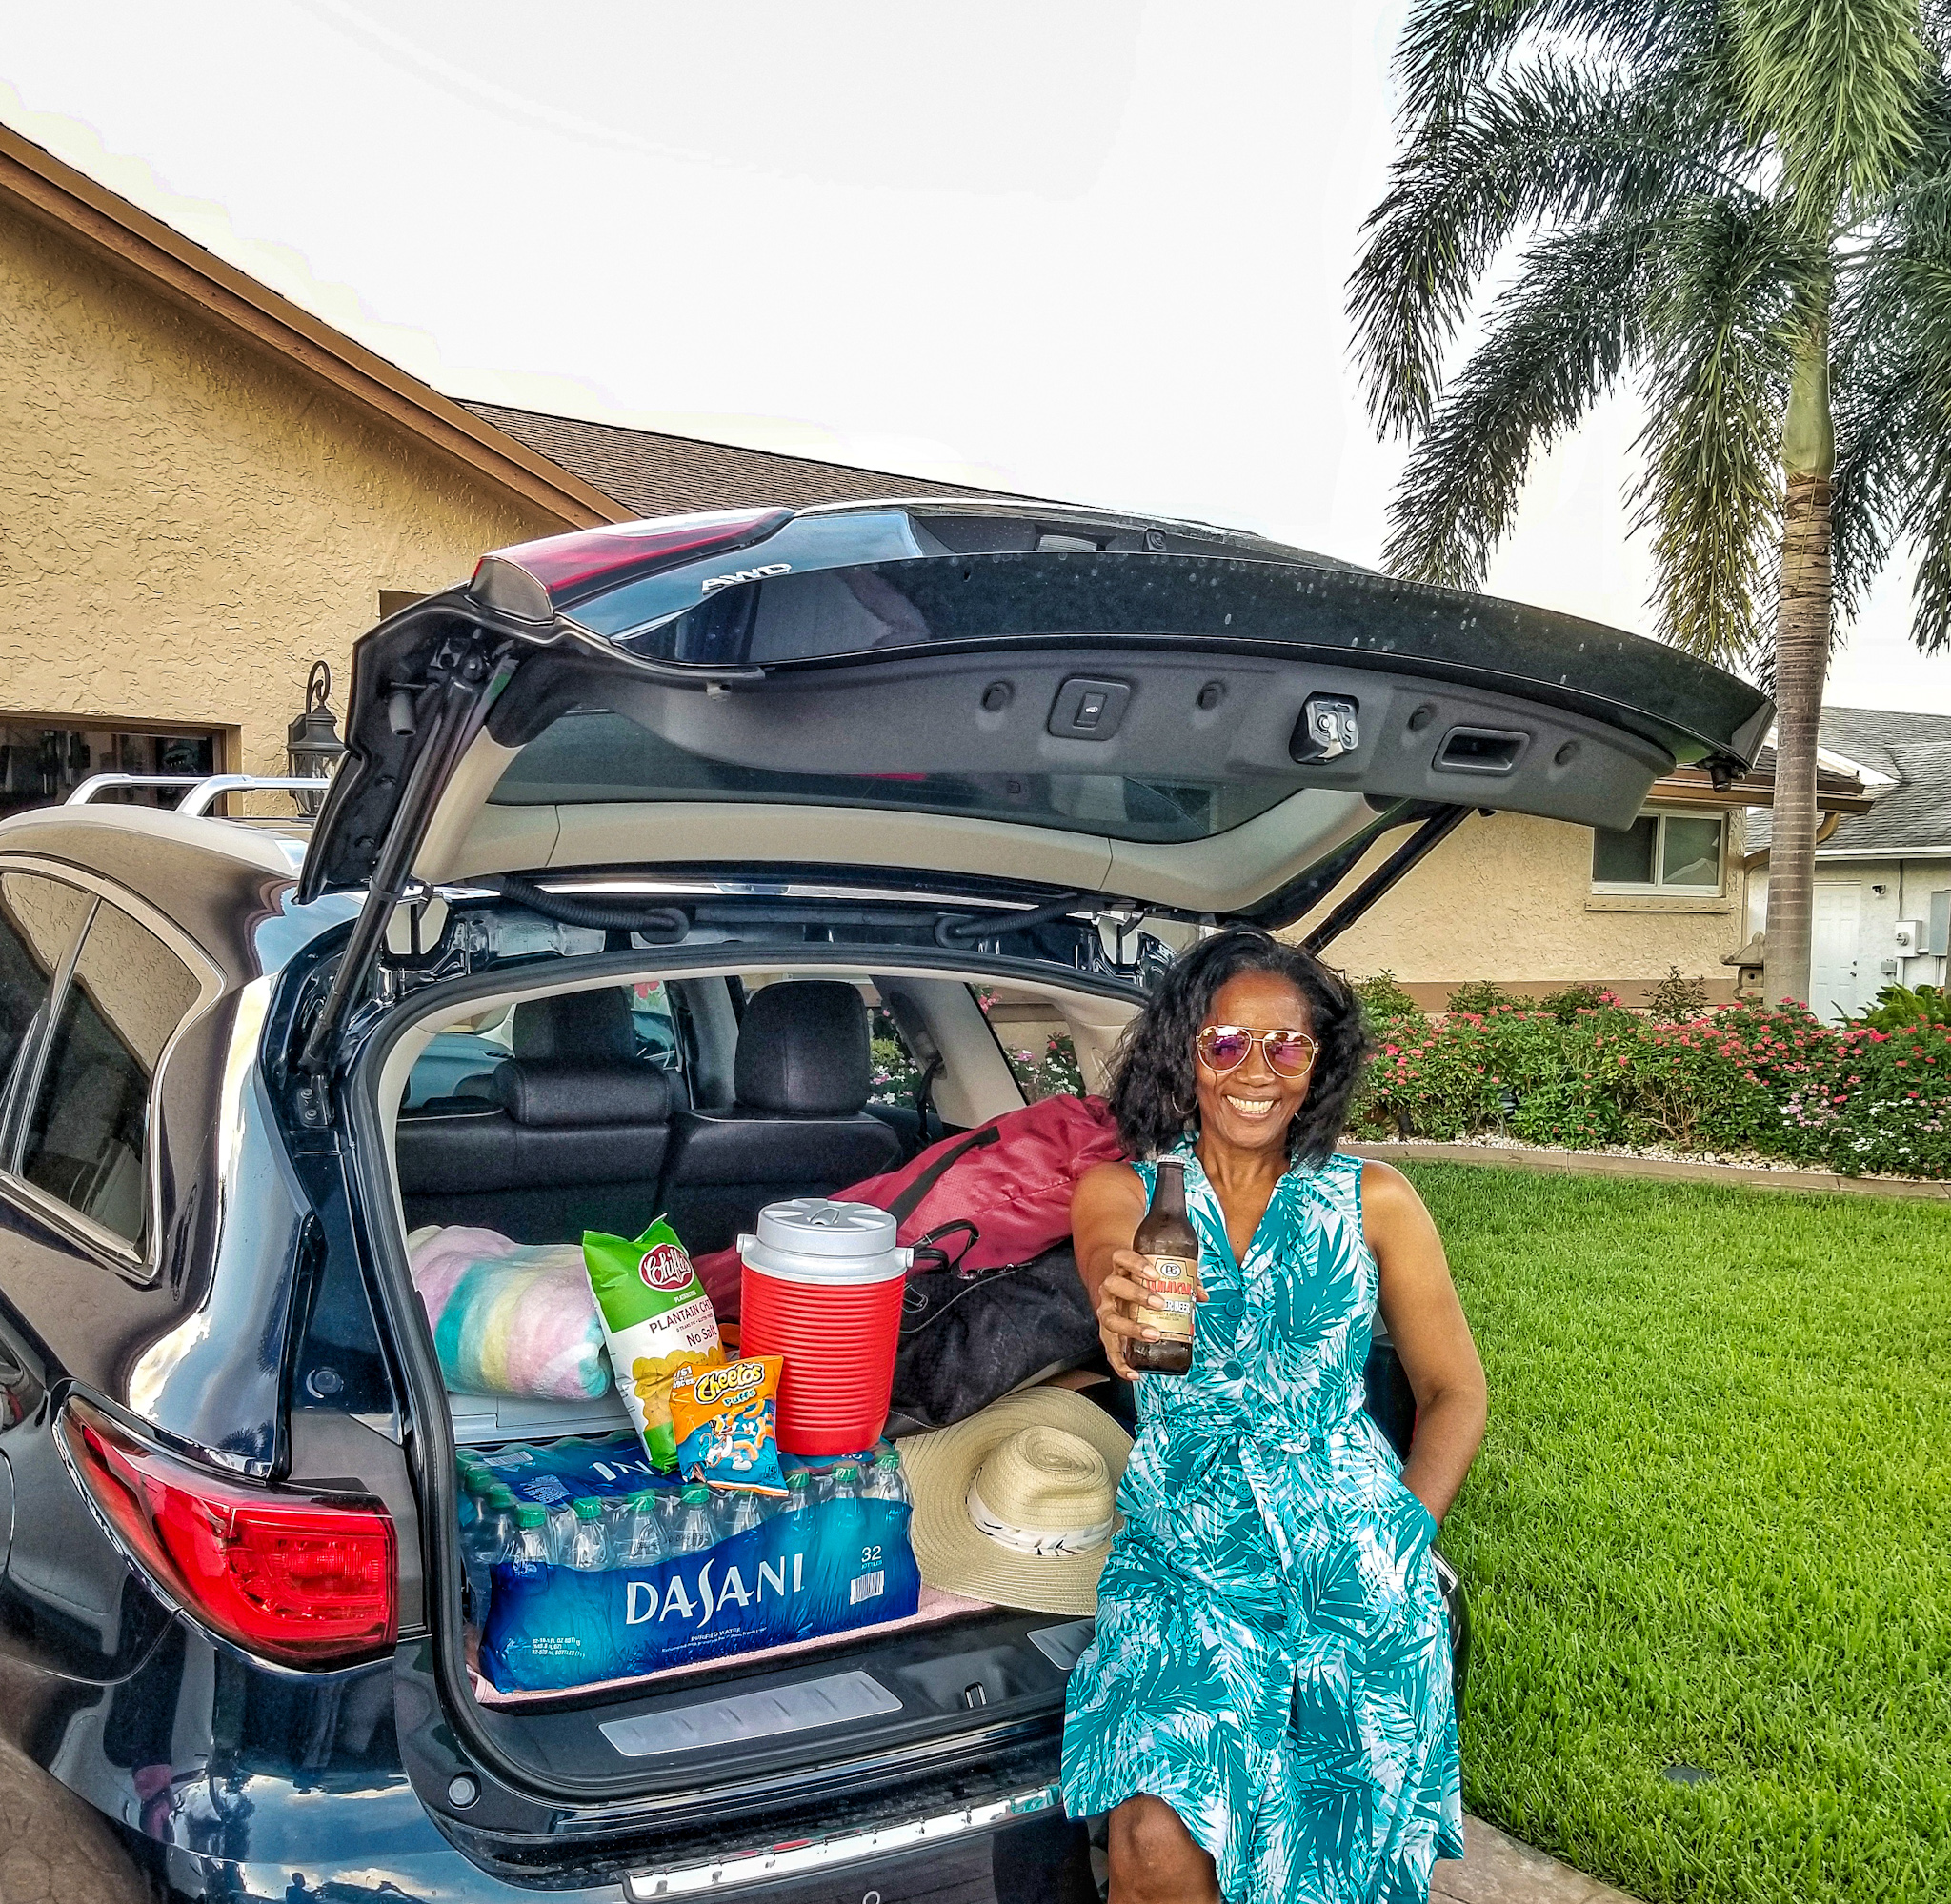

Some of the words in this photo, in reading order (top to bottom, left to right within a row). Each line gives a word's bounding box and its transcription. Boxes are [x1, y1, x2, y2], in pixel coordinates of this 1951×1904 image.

[702, 564, 792, 591] AWD
[649, 1303, 700, 1334] PLANTAIN
[699, 1299, 714, 1313] CHI
[1175, 1301, 1191, 1314] BEER
[686, 1333, 702, 1347] No
[701, 1324, 717, 1339] Salt
[697, 1364, 763, 1401] Cheetos
[723, 1388, 756, 1406] Puffs
[861, 1545, 882, 1562] 32
[626, 1553, 803, 1628] DASANI
[719, 1627, 741, 1636] WATER
